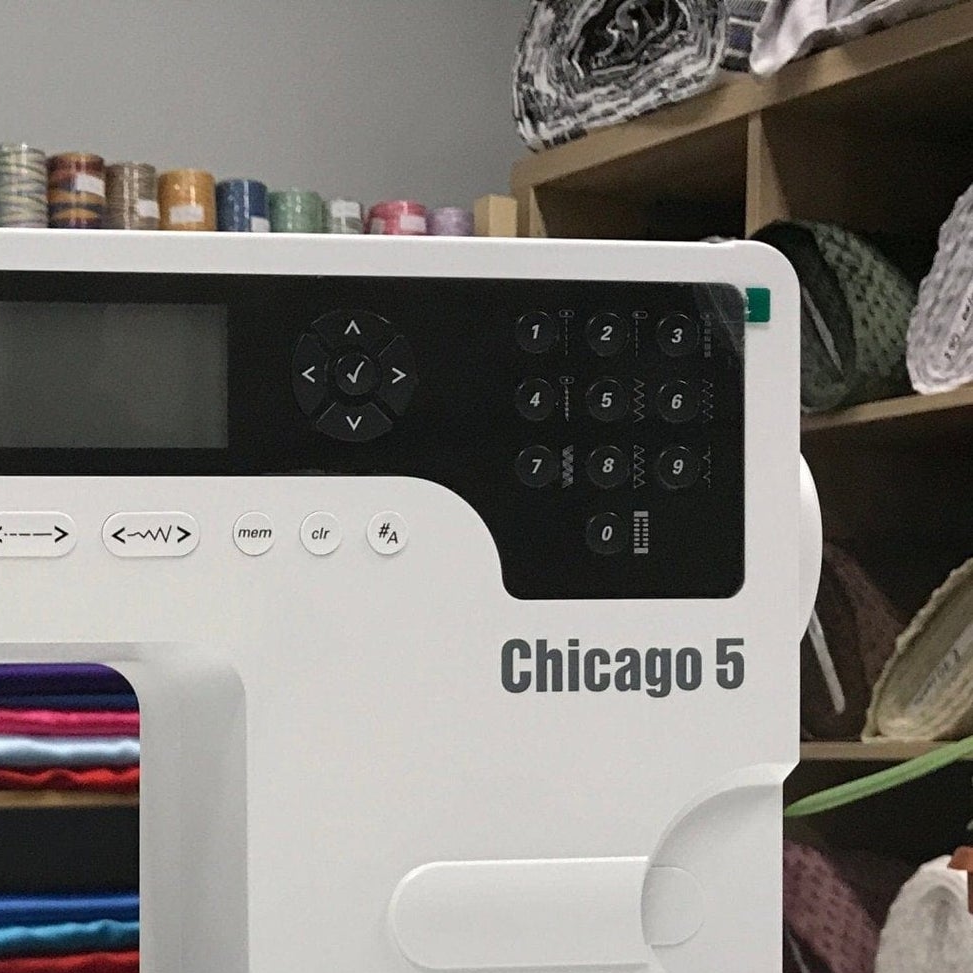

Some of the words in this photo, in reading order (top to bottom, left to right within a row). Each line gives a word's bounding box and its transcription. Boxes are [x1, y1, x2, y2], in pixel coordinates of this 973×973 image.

[531, 324, 541, 339] 1
[600, 325, 613, 341] 2
[671, 328, 683, 344] 3
[529, 391, 541, 407] 4
[601, 392, 613, 408] 5
[671, 393, 683, 409] 6
[531, 458, 542, 474] 7
[601, 457, 615, 473] 8
[672, 459, 684, 475] 9
[237, 528, 273, 538] mem
[311, 527, 330, 540] clr
[601, 525, 613, 541] 0
[500, 638, 703, 698] Chicago
[715, 637, 745, 690] 5
